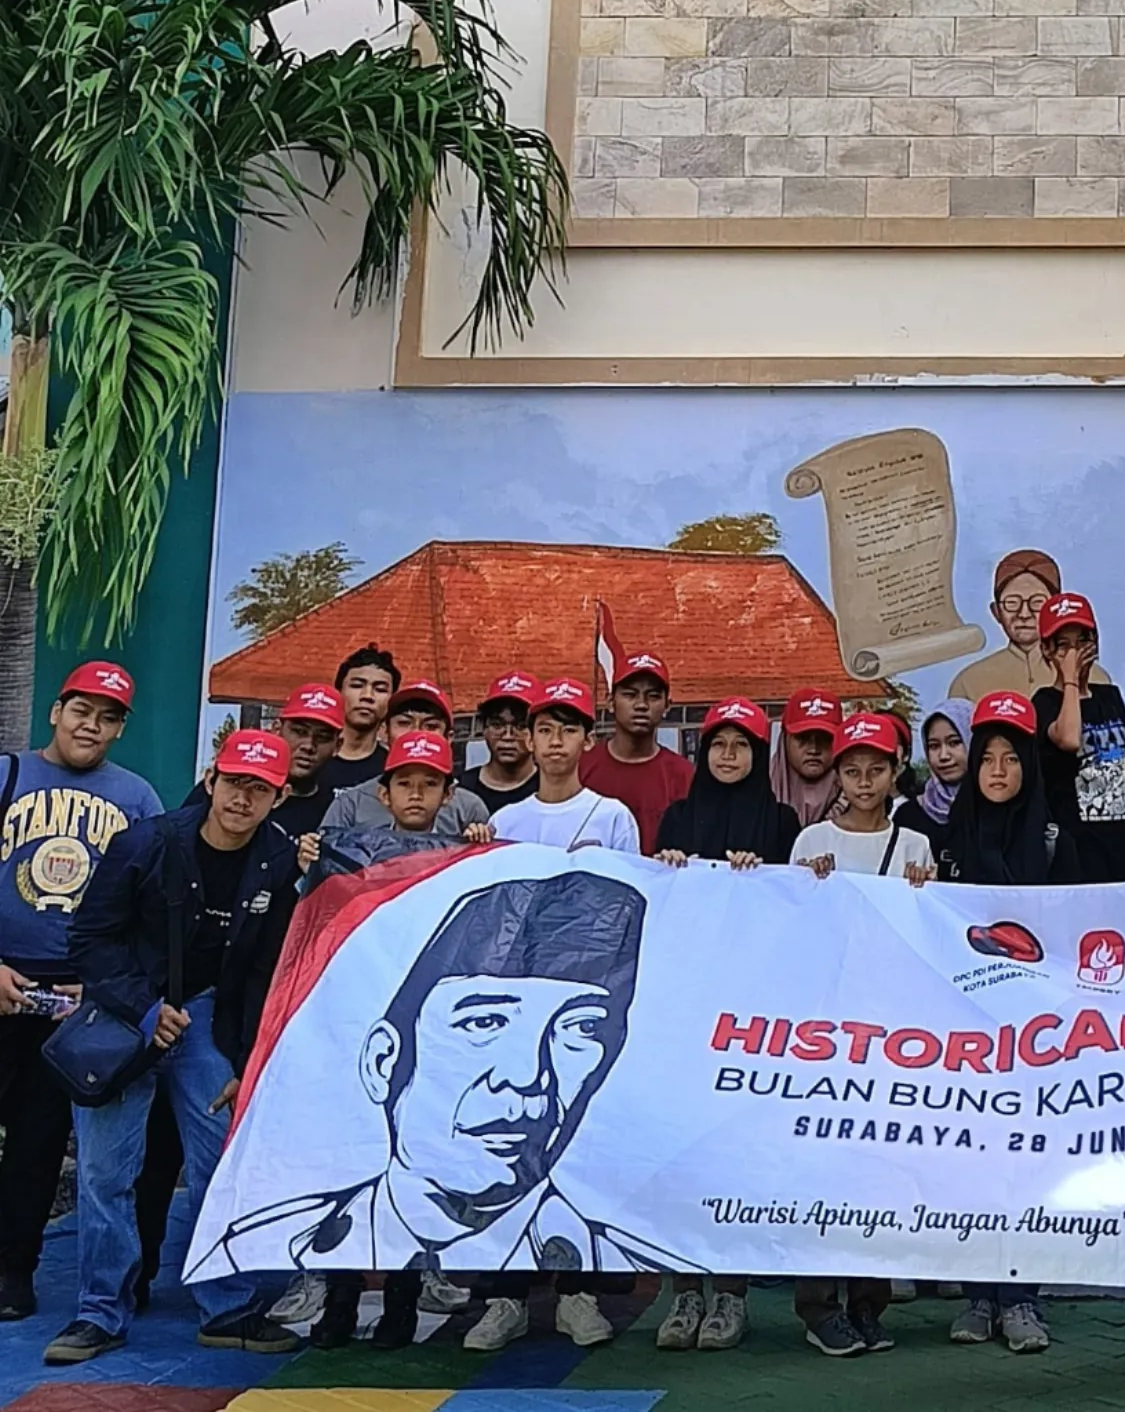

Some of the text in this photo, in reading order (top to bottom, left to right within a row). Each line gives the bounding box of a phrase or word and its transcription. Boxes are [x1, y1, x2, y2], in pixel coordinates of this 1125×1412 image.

[1, 787, 129, 861] STANFOR
[714, 1067, 875, 1103] BULAN
[888, 1082, 1022, 1116] BUNG
[1007, 1132, 1047, 1153] 28
[802, 1200, 903, 1239] Apinya,
[909, 1204, 1010, 1242] Jangan
